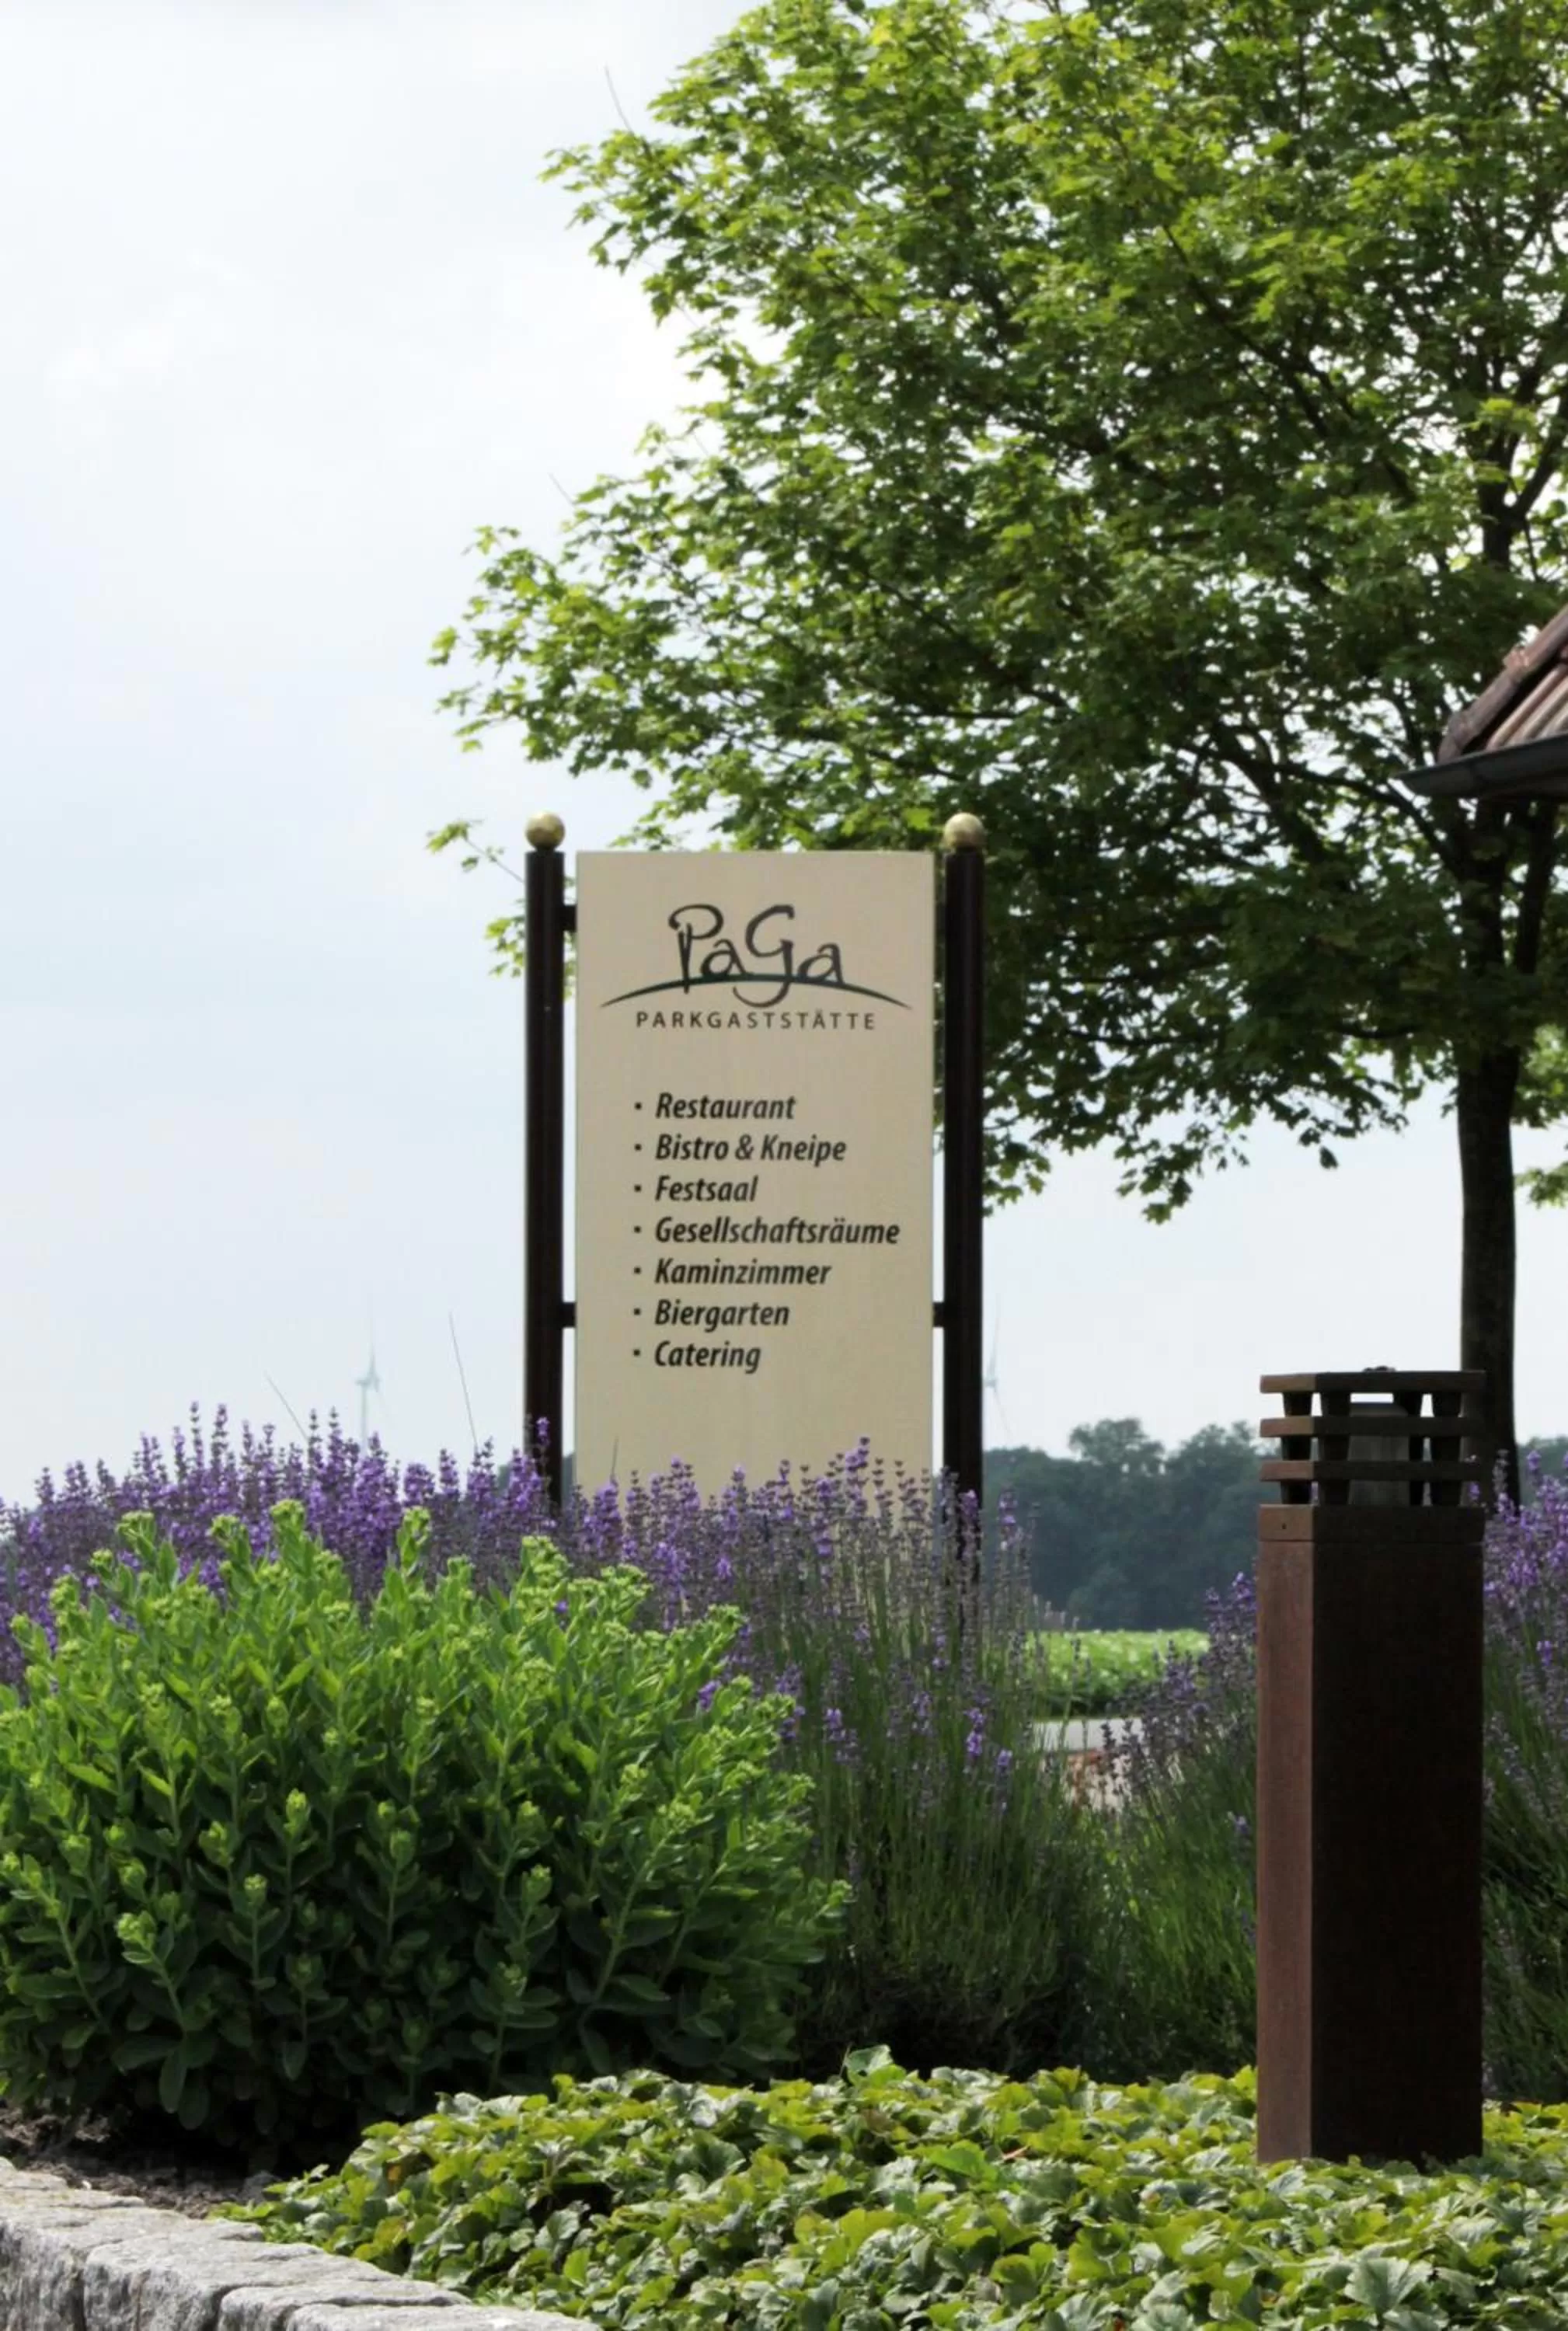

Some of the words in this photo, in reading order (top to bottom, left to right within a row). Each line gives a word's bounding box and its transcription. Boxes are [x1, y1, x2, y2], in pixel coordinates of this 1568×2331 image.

[667, 904, 845, 1008] PaGa
[636, 1009, 876, 1030] PARKGASTSTÄTTE
[655, 1092, 796, 1120] Restaurant
[655, 1133, 730, 1161] Bistro
[734, 1134, 754, 1161] &
[760, 1134, 847, 1167] Kneipe
[654, 1174, 758, 1202] Festsaal
[654, 1216, 901, 1244] Gesellschaftsräume
[653, 1257, 831, 1284] Kaminzimmer
[654, 1298, 790, 1333] Biergarten
[654, 1340, 761, 1375] Catering
